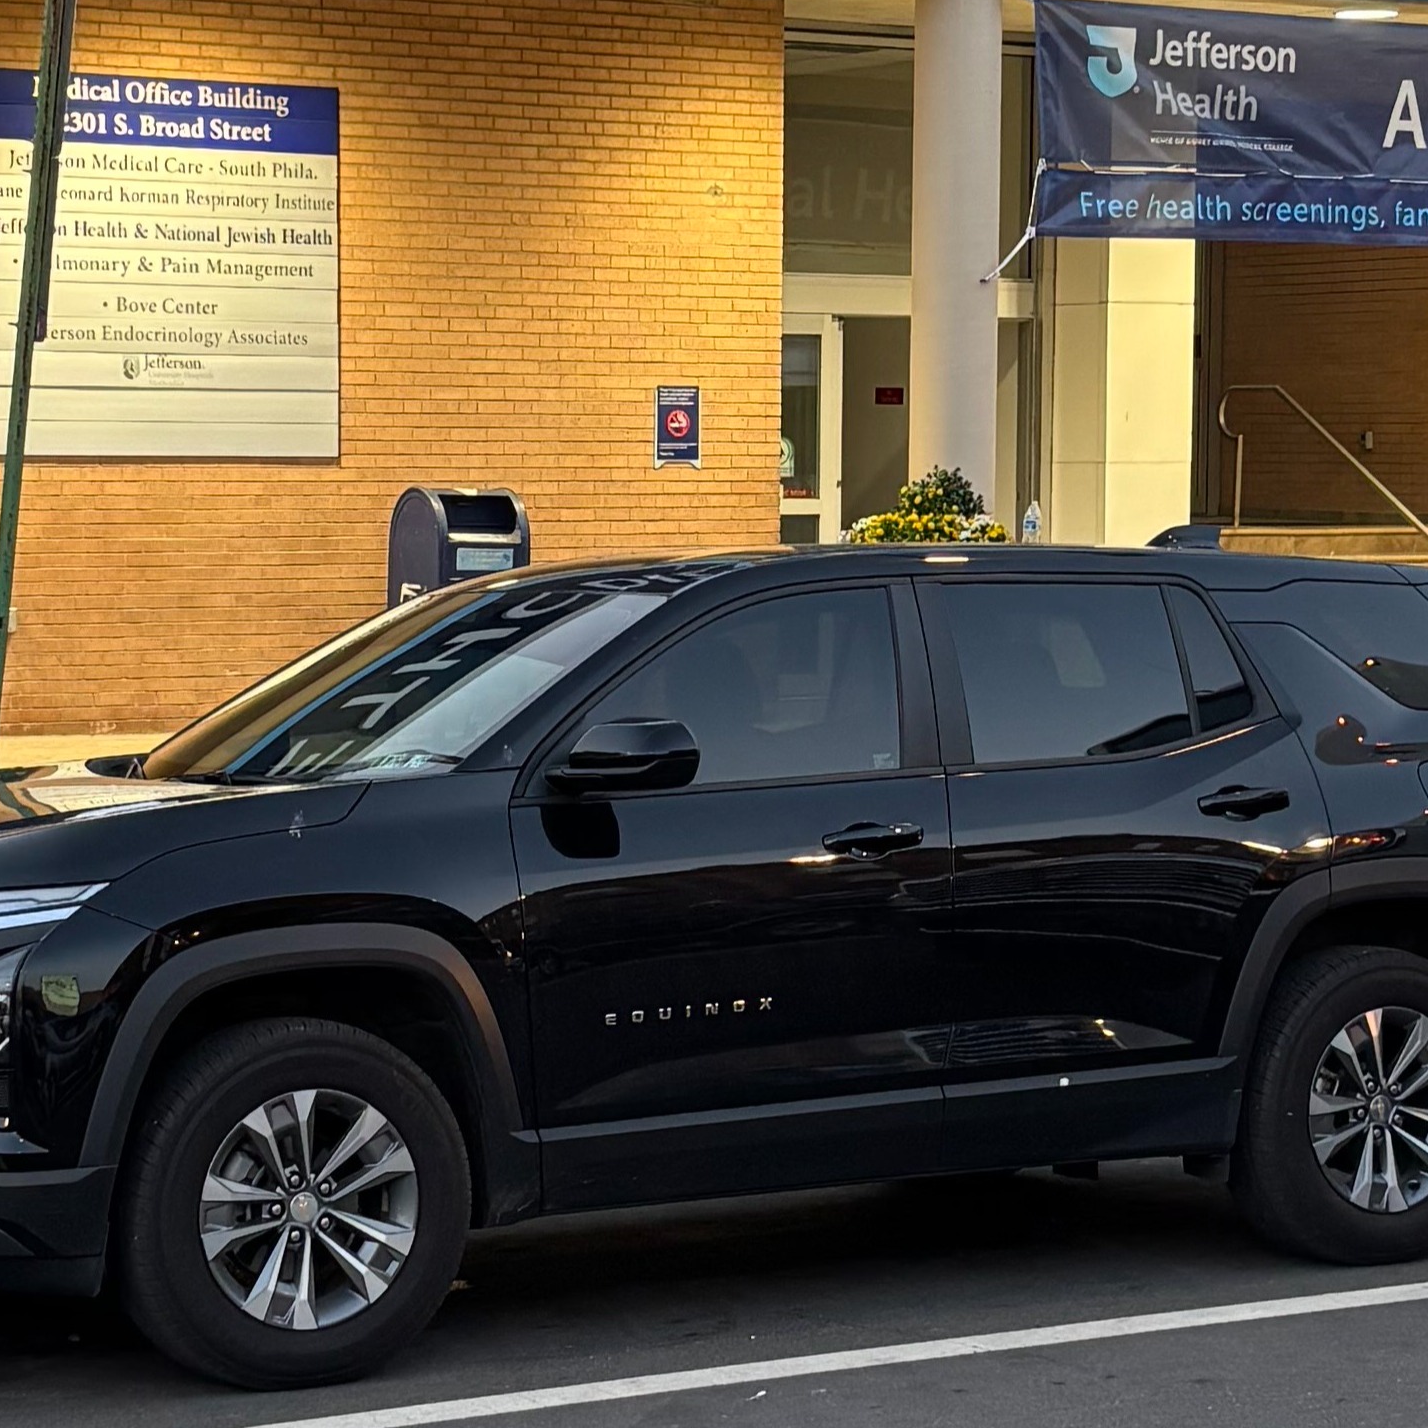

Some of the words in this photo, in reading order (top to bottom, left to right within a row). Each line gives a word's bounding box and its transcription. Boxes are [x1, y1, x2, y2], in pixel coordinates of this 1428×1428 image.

[1149, 28, 1297, 73] Jefferson
[124, 80, 193, 106] Office
[197, 85, 290, 118] Building
[1152, 80, 1258, 122] Health
[113, 112, 135, 136] S.
[139, 114, 205, 139] Broad
[209, 118, 273, 142] Street
[92, 153, 159, 173] Medical
[164, 156, 204, 174] Care
[219, 159, 267, 178] South
[271, 161, 318, 180] Phila.
[60, 185, 113, 202] eonard
[120, 186, 179, 205] Korman
[185, 188, 270, 214] Respiratory
[275, 193, 335, 212] Institute
[1079, 191, 1140, 218] Free
[1146, 192, 1232, 221] health
[1241, 196, 1384, 232] screenings,
[73, 219, 128, 239] Health
[134, 222, 149, 240] &
[155, 223, 221, 243] National
[224, 225, 276, 249] Jewish
[281, 228, 334, 246] Health
[55, 253, 131, 277] lmonary
[137, 256, 153, 273] &
[160, 256, 200, 274] Pain
[206, 258, 314, 282] Management
[116, 295, 158, 314] Bove
[162, 297, 219, 316] Center
[102, 325, 223, 348] Endocrinology
[227, 329, 309, 346] Associates
[143, 352, 202, 371] Jefferson
[605, 996, 773, 1026] EQUINOX
